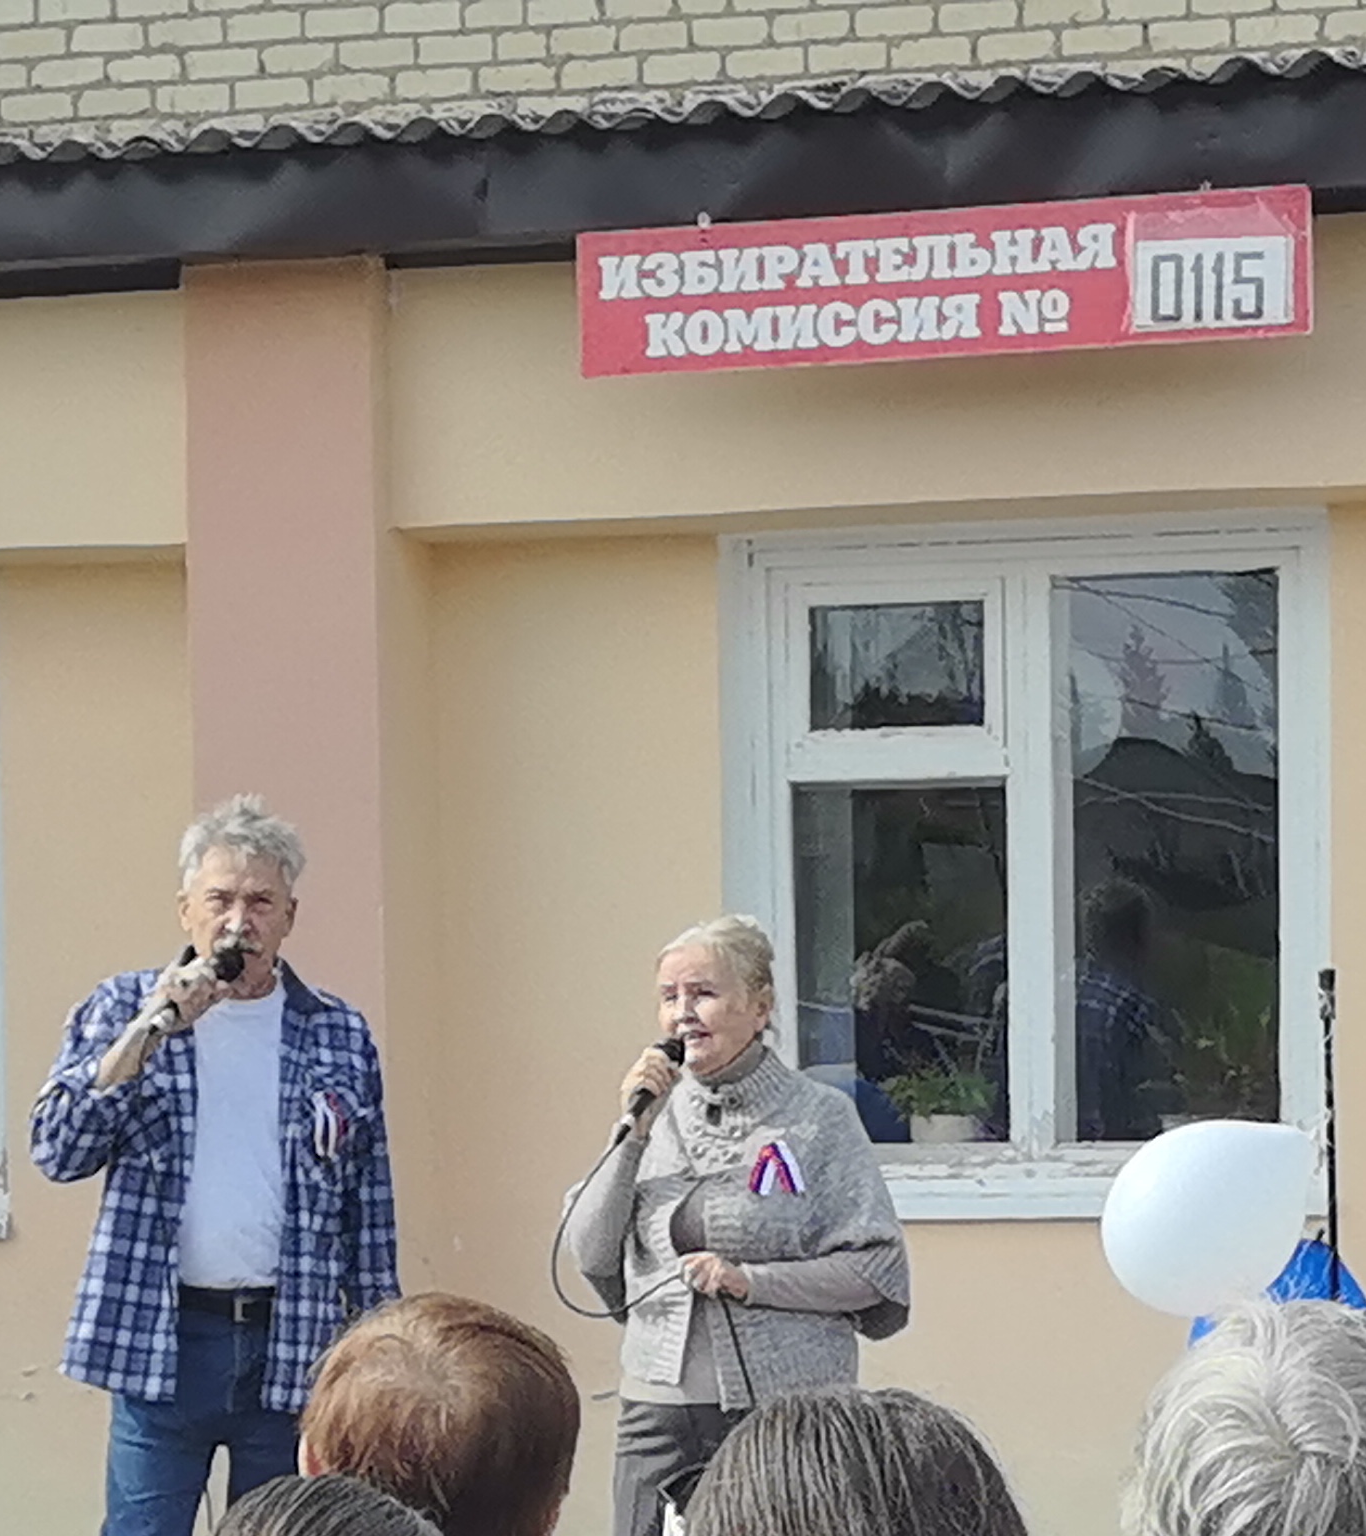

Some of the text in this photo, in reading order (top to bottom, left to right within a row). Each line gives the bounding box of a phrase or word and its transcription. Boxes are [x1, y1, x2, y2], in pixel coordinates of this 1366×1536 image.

[598, 223, 1116, 300] ИЗБИРАТЕЛЬНАЯ
[644, 250, 1265, 358] КОМИССИЯ № 0115
